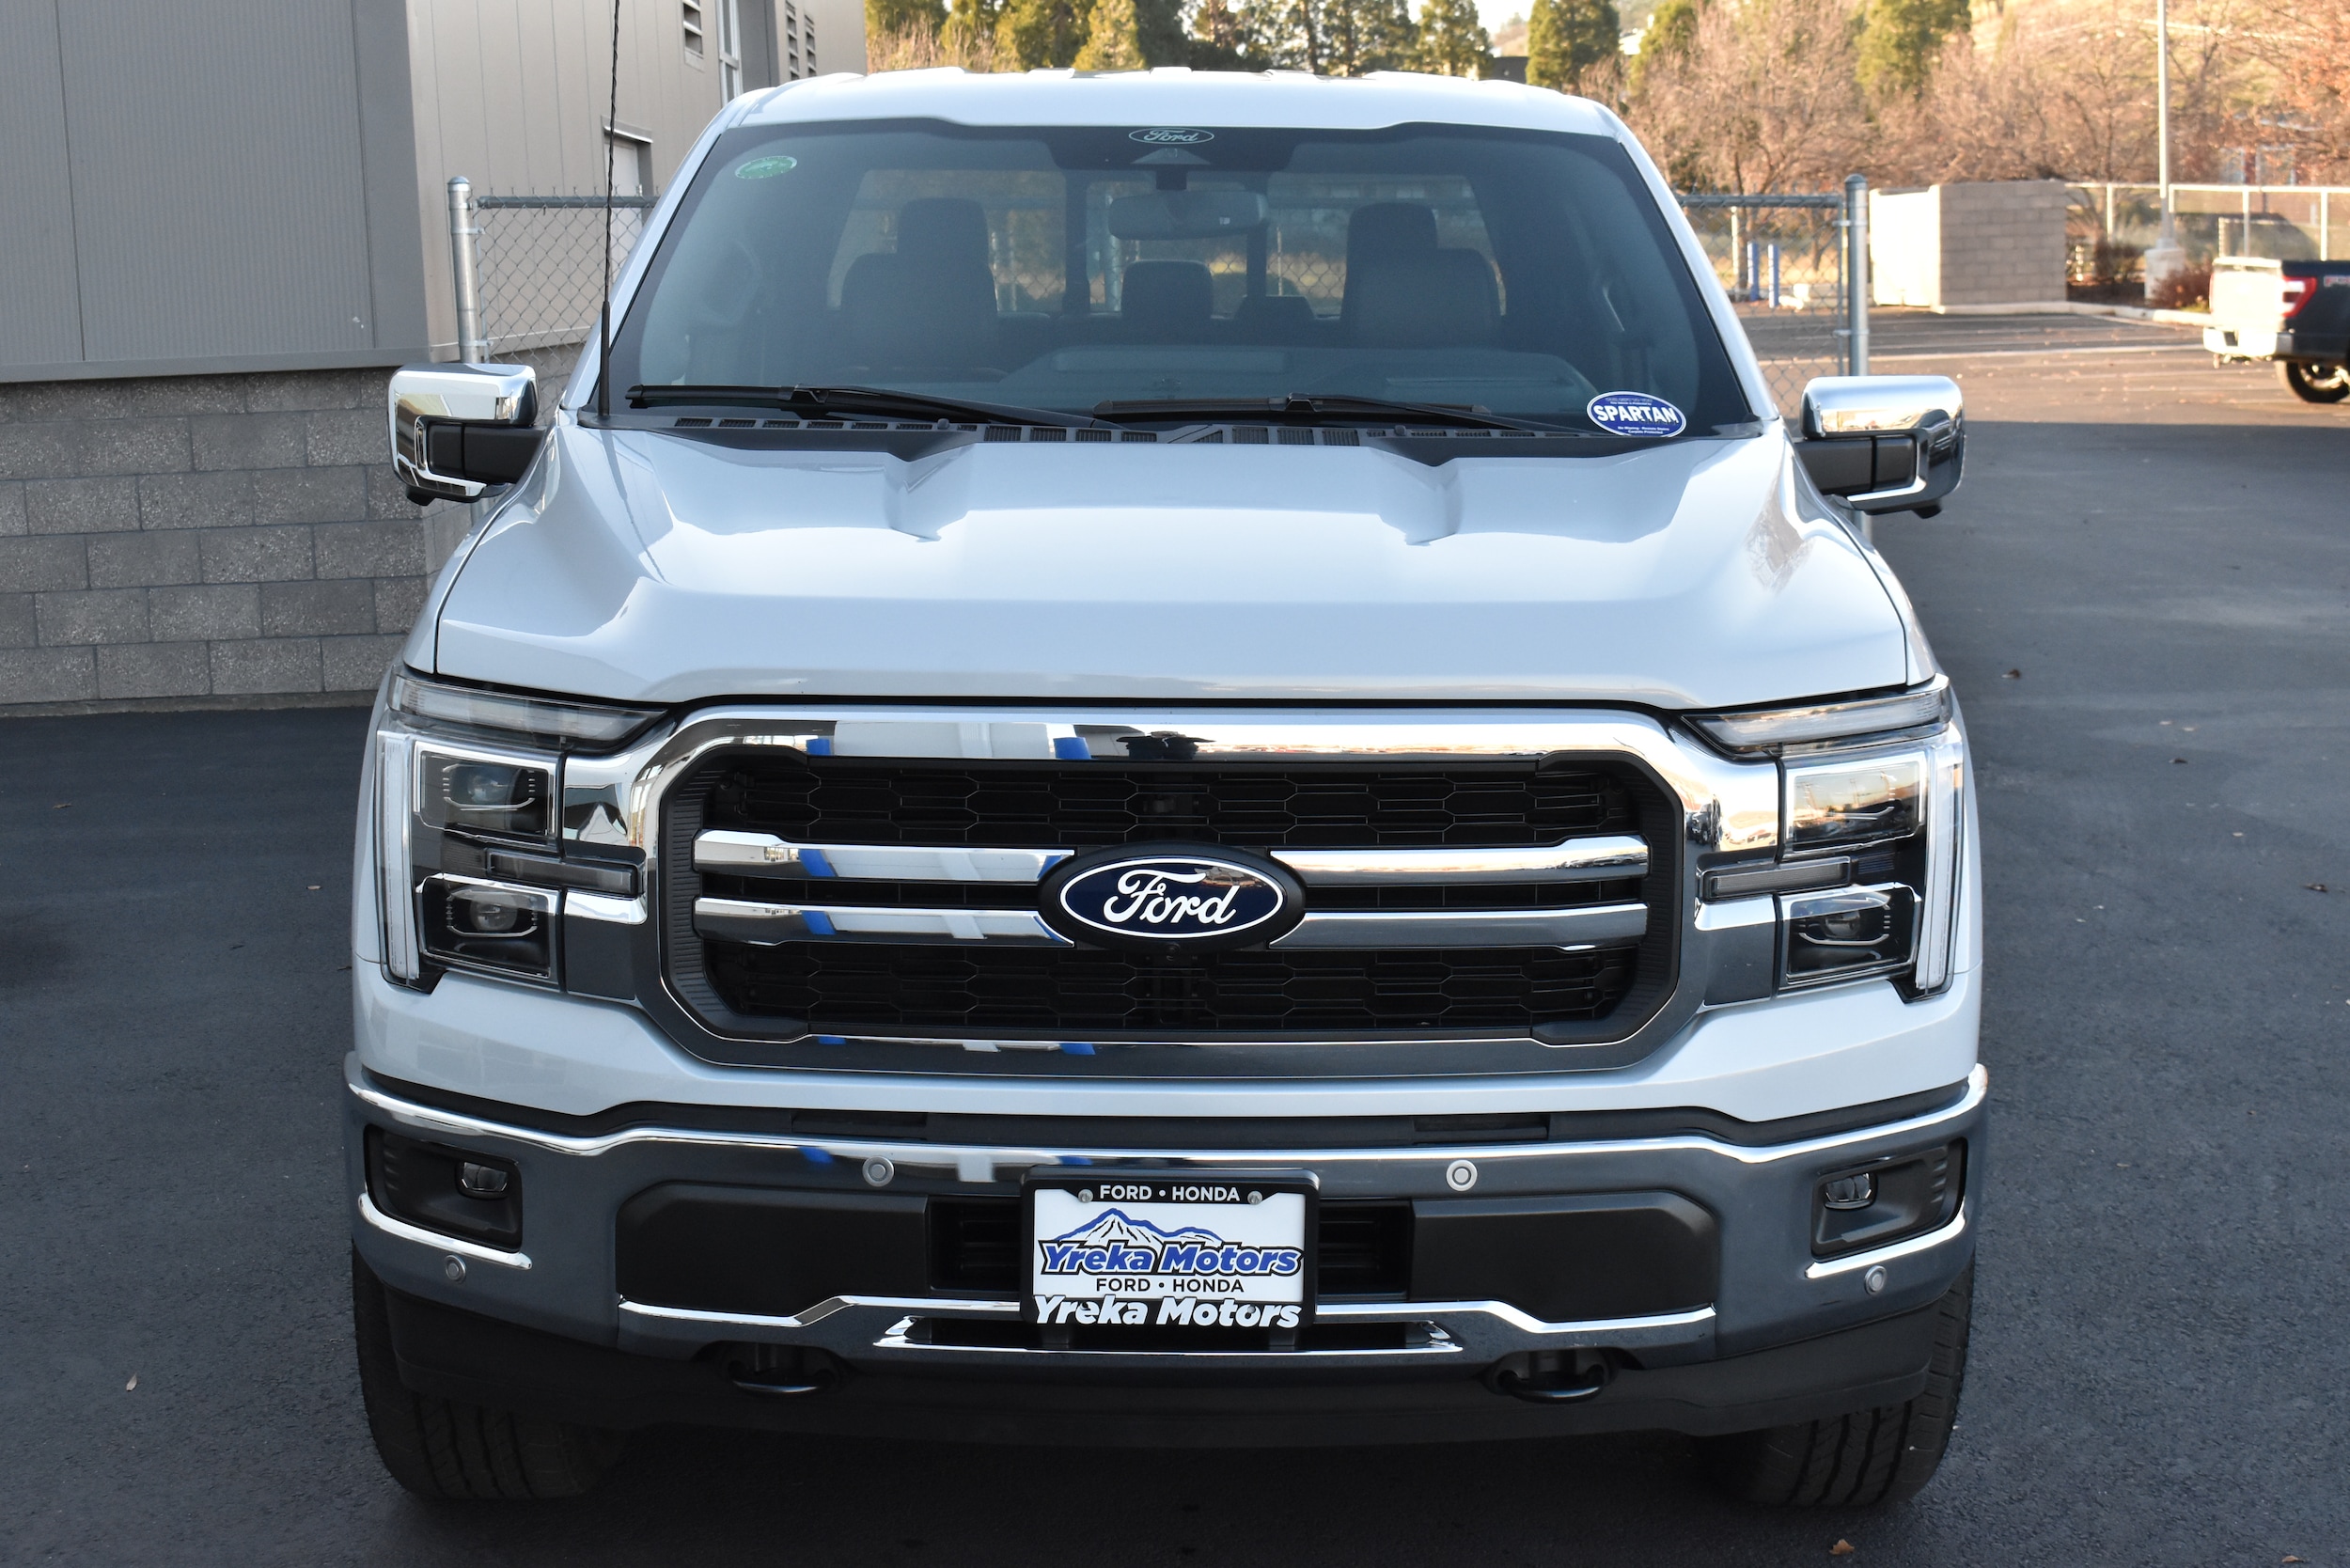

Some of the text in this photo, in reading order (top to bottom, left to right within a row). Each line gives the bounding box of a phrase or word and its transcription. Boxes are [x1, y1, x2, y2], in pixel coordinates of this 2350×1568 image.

[1143, 130, 1199, 142] Ford
[1593, 405, 1679, 424] SPARTAN
[1103, 869, 1241, 925] Ford
[1099, 1184, 1241, 1202] FORD HONDA
[1041, 1242, 1303, 1275] Yreka Motors
[1095, 1278, 1245, 1294] FORD HONDA
[1033, 1294, 1303, 1329] Yreka Motors
